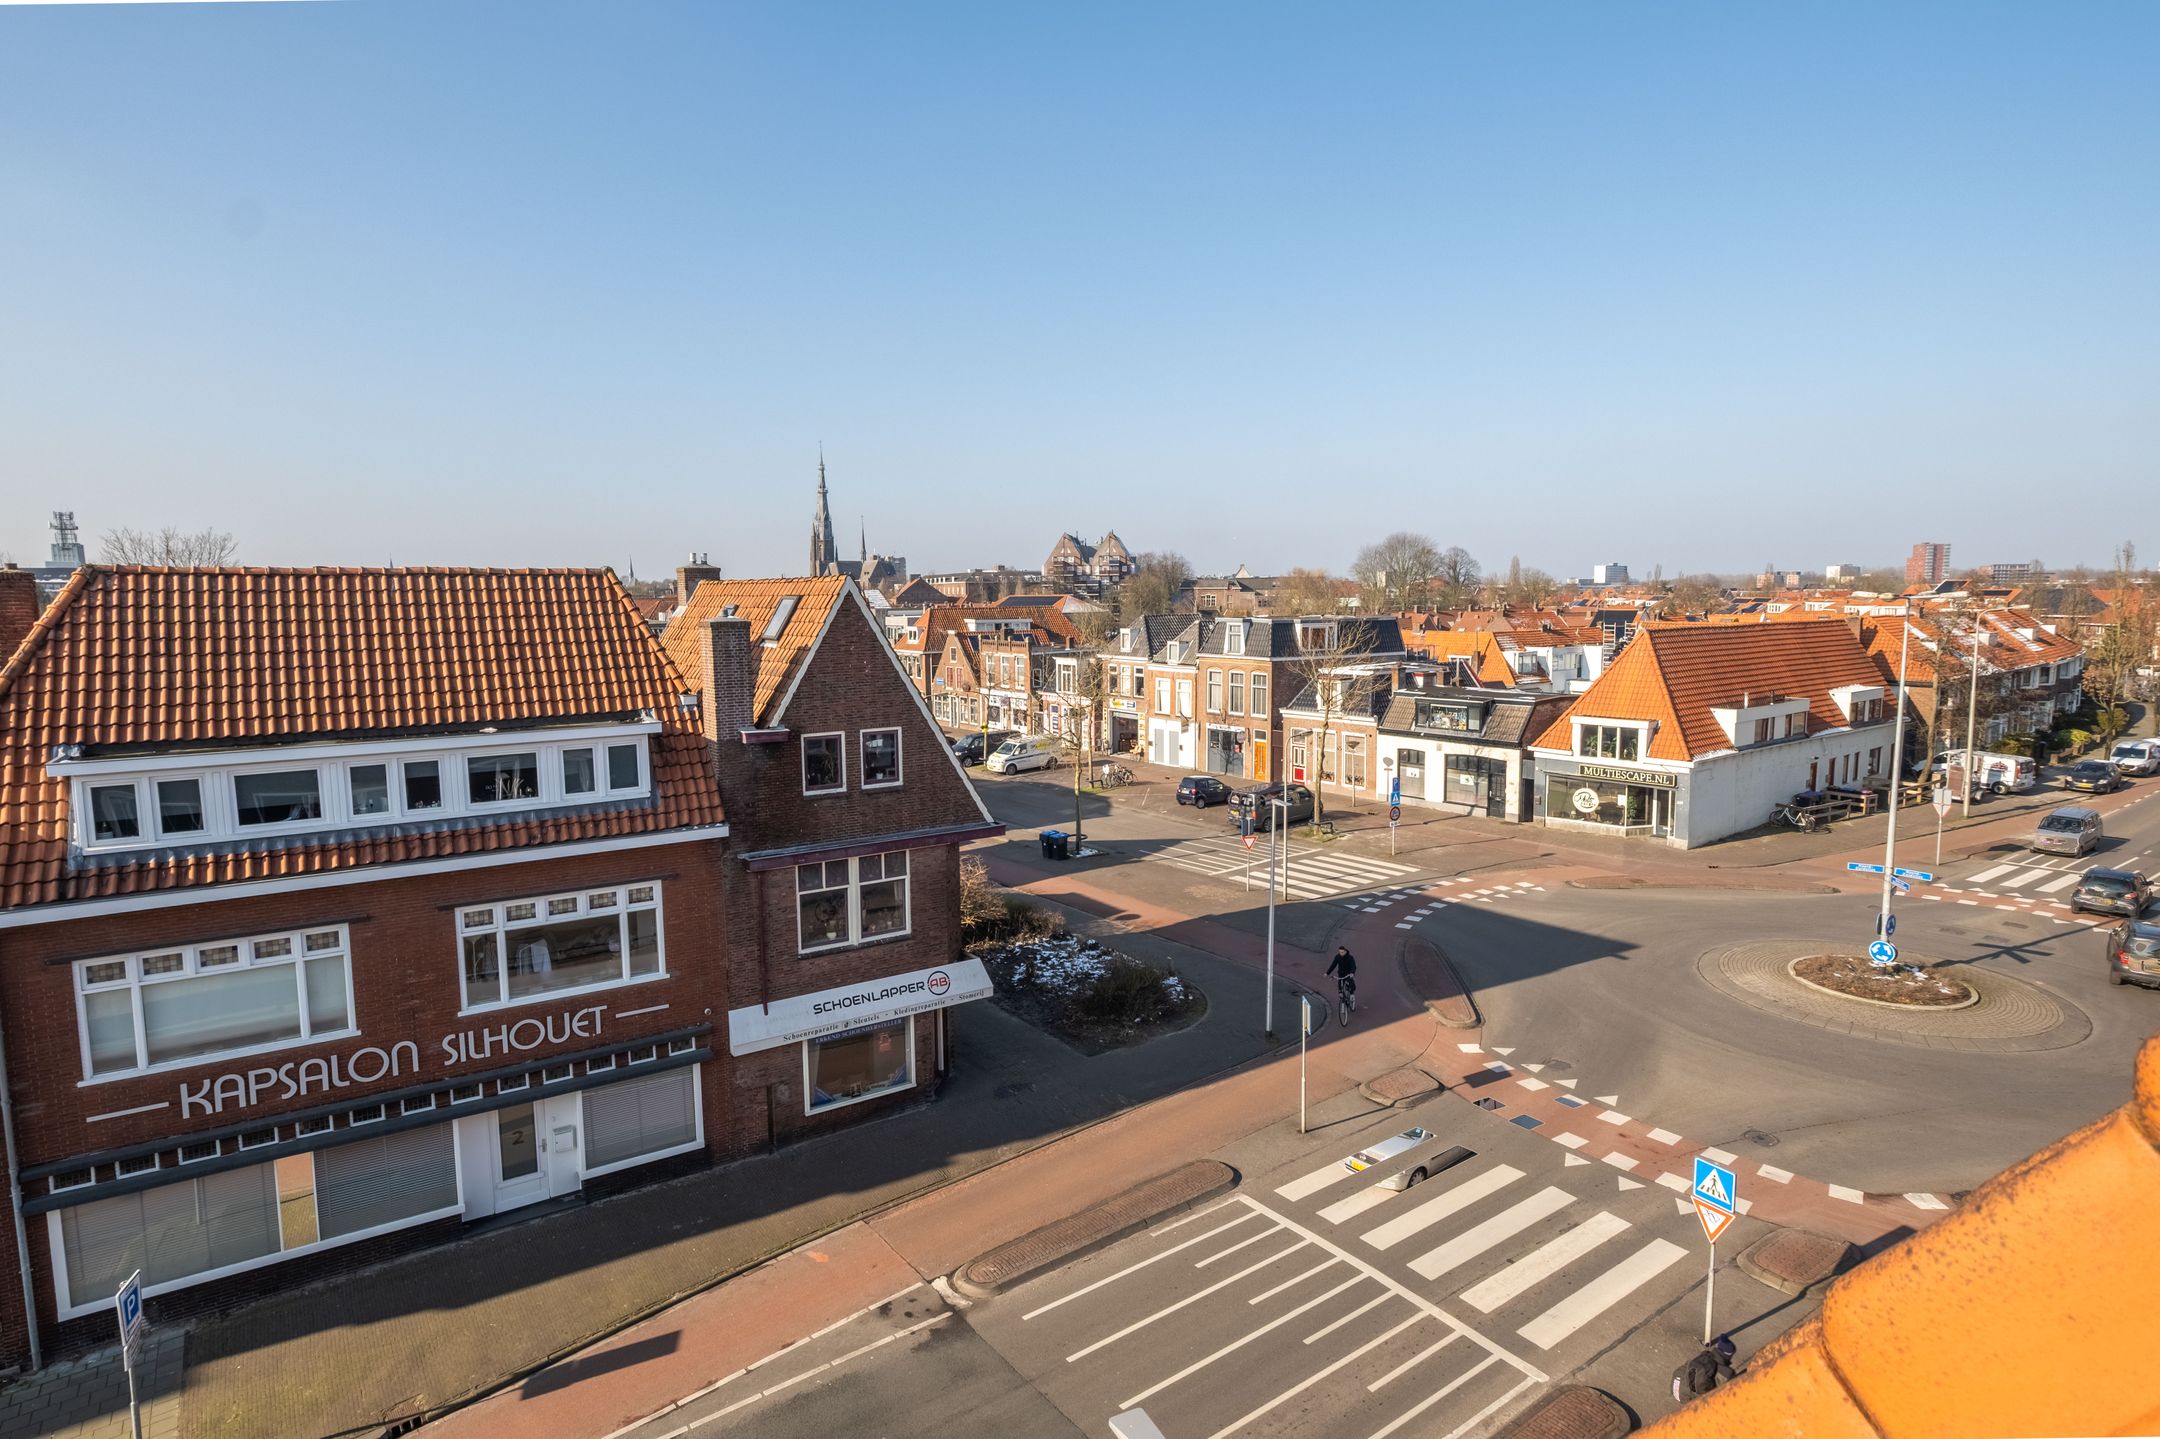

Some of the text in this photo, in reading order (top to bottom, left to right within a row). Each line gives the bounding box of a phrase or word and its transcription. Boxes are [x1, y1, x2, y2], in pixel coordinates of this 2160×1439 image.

[1583, 766, 1670, 784] MULTIESCAPE.NL
[813, 976, 948, 1015] SCHOENLAPPER AB
[783, 989, 985, 1042] Schoenreparatie Sleutels Kledingreparatie Stomerij
[815, 1033, 841, 1044] ERKEND
[179, 1004, 608, 1120] KAPSALON SILHOUET
[511, 1130, 525, 1146] 2
[127, 1293, 136, 1320] P
